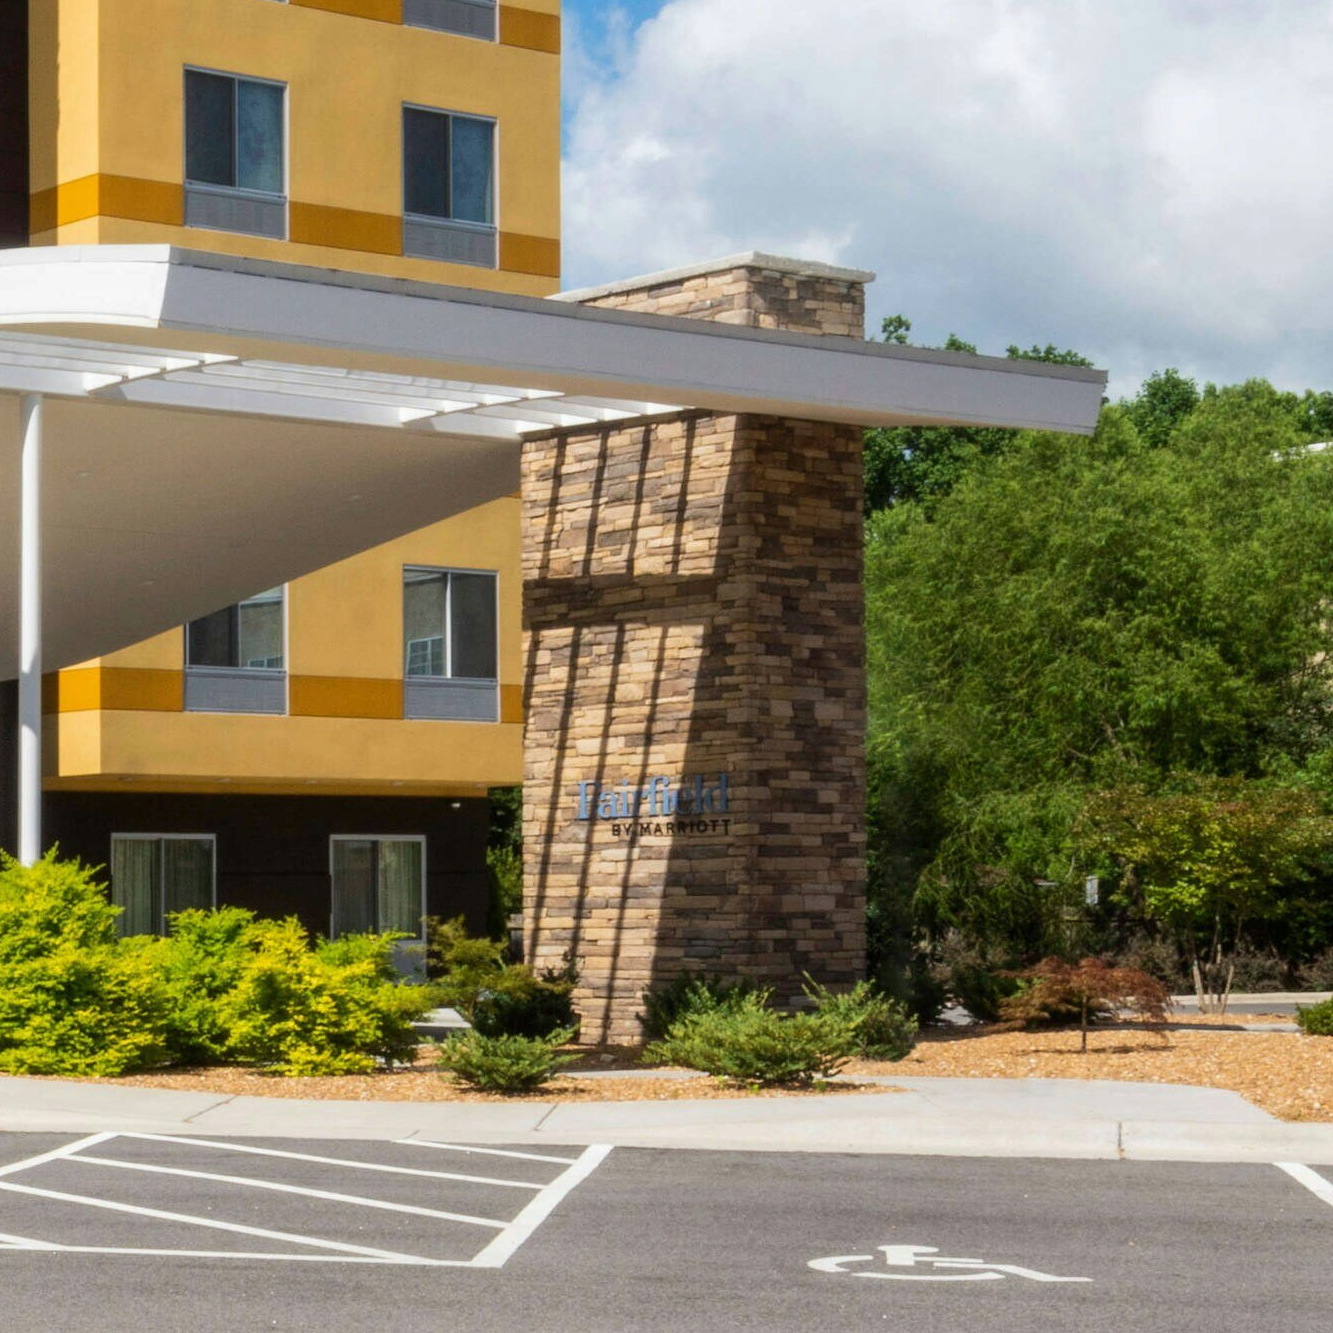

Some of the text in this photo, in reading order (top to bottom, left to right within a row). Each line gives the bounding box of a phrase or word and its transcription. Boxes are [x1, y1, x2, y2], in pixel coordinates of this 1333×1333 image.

[576, 773, 729, 821] Fairfield
[611, 819, 731, 836] BY MARRIOTT
